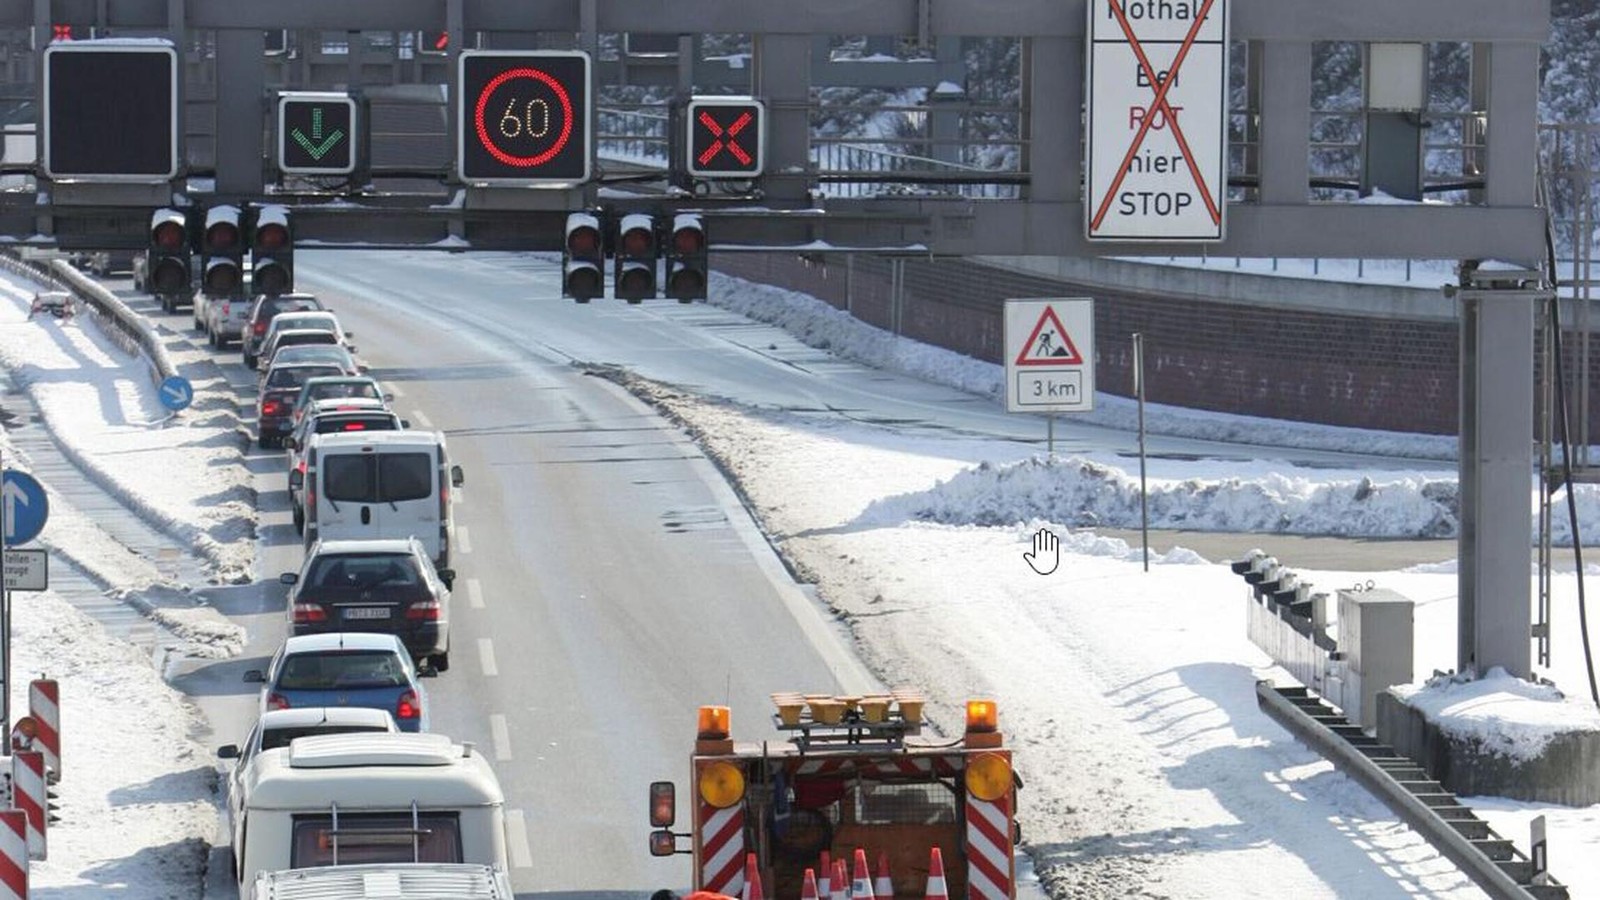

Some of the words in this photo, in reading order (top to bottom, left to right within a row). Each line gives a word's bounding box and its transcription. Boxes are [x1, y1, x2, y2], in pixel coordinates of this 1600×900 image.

[500, 98, 548, 138] 60
[1129, 106, 1184, 131] ROT
[1118, 192, 1192, 216] STOP
[1033, 380, 1043, 397] 3
[1048, 381, 1076, 396] km
